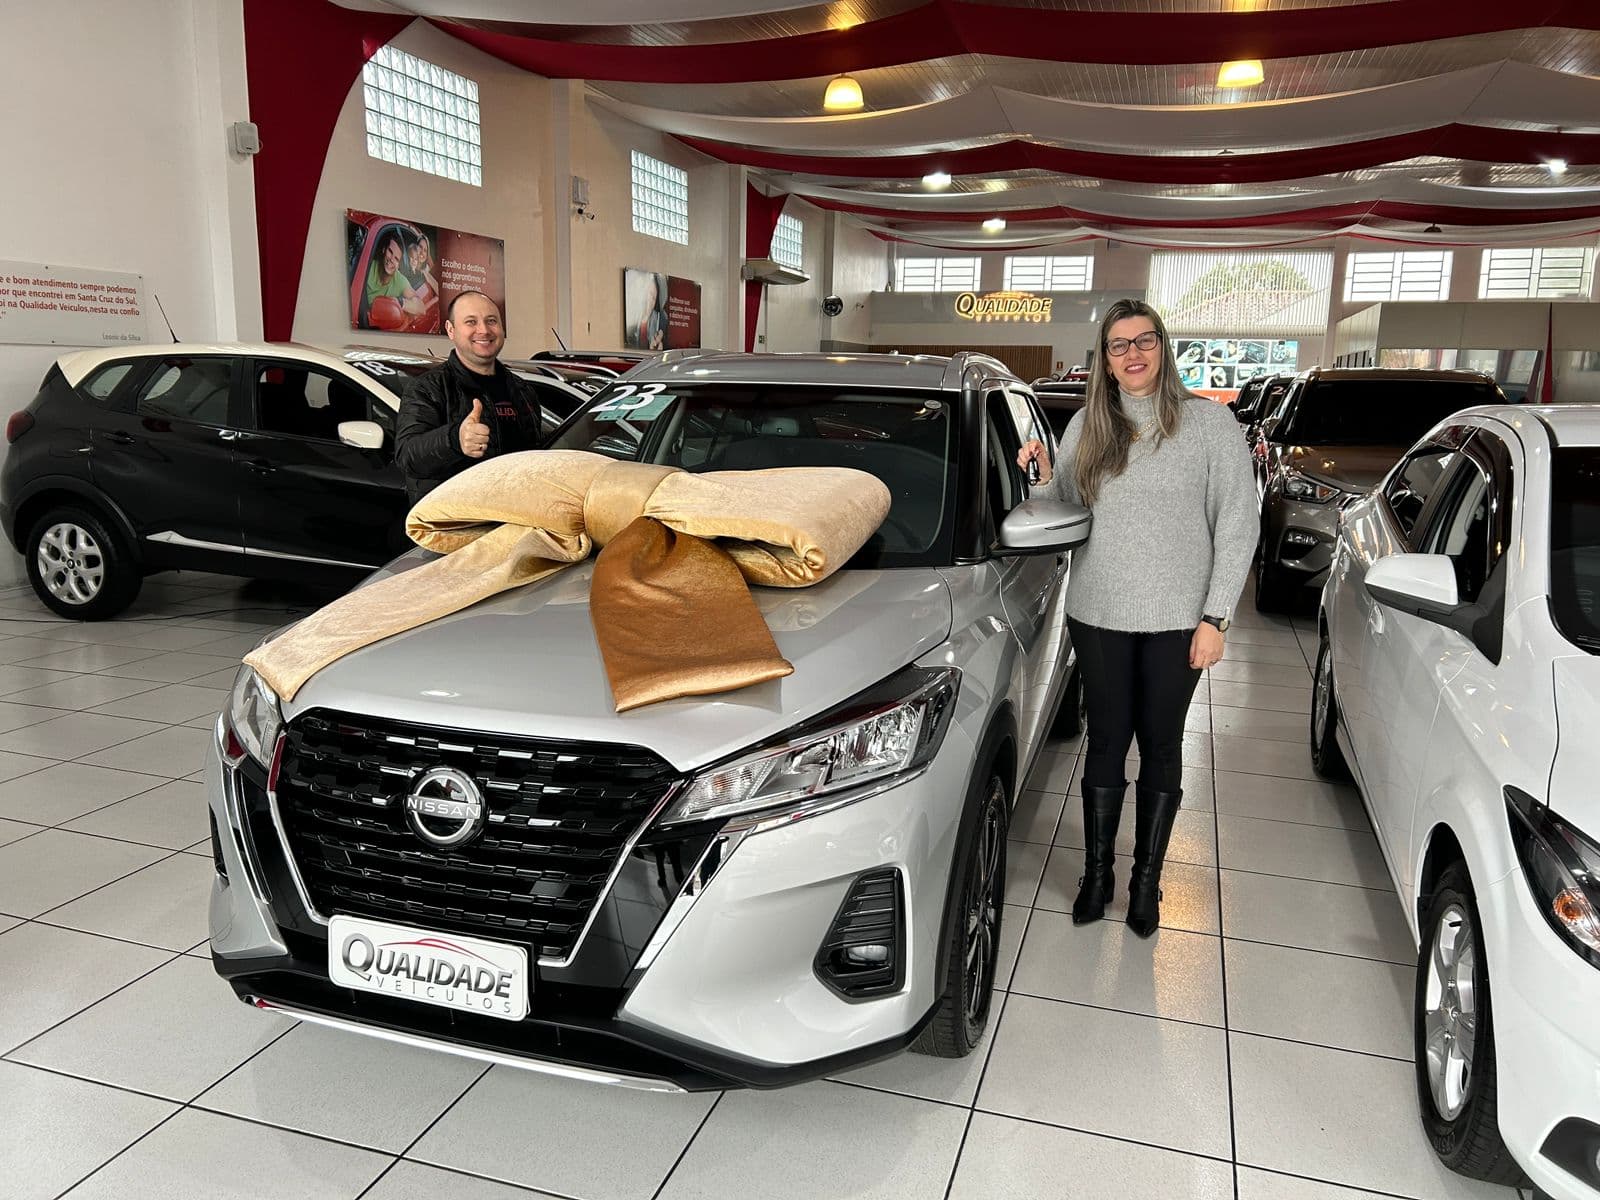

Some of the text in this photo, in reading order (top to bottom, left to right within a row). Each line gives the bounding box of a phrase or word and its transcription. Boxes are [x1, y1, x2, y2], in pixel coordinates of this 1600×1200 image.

[6, 276, 11, 284] e
[12, 275, 30, 285] bom
[32, 278, 78, 289] atendimento
[80, 282, 105, 292] sempre
[106, 284, 137, 295] podemos
[442, 282, 461, 290] melhor
[12, 289, 27, 298] que
[28, 290, 63, 299] encontrei
[77, 292, 97, 302] Santa
[98, 294, 114, 303] Cruz
[114, 296, 124, 304] do
[955, 293, 1052, 318] QUALIDADE
[19, 300, 58, 311] Qualidade
[119, 307, 140, 316] confio
[353, 360, 397, 376] 18
[571, 381, 601, 393] 16
[588, 383, 668, 413] 23
[407, 797, 479, 817] NISSAN
[341, 932, 513, 999] QUALIDADE
[376, 976, 511, 1014] VEICULOS
